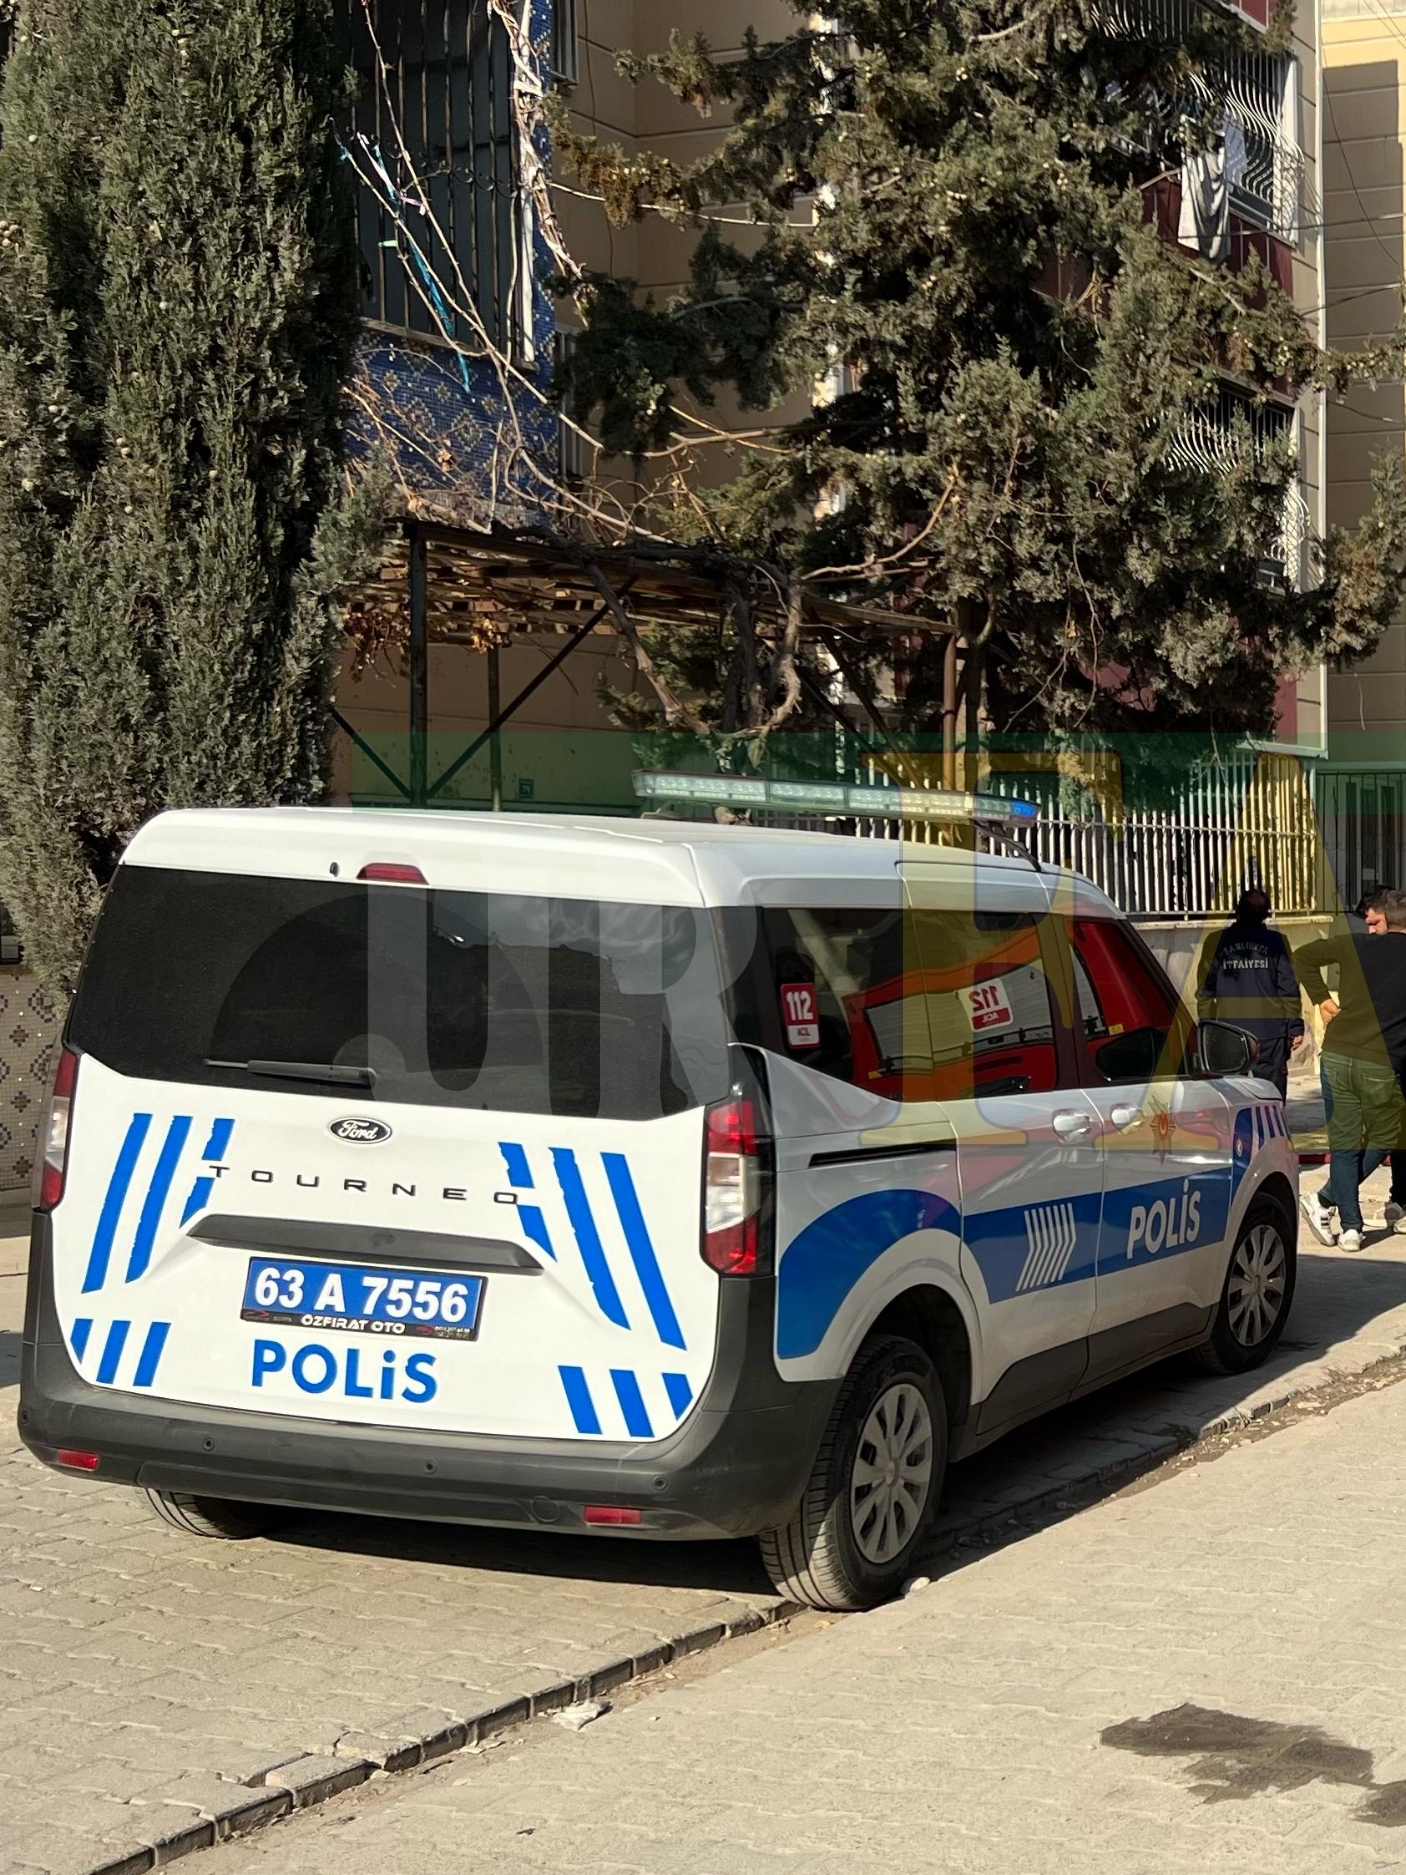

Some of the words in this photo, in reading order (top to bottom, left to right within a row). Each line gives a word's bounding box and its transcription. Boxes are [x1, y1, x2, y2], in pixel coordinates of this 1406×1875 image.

[786, 990, 814, 1021] 112
[337, 1119, 378, 1141] Ford
[208, 1164, 520, 1206] TOURNEO
[254, 1266, 306, 1309] 63
[314, 1273, 346, 1314] A
[361, 1275, 469, 1323] 7556
[370, 1321, 406, 1334] OTO
